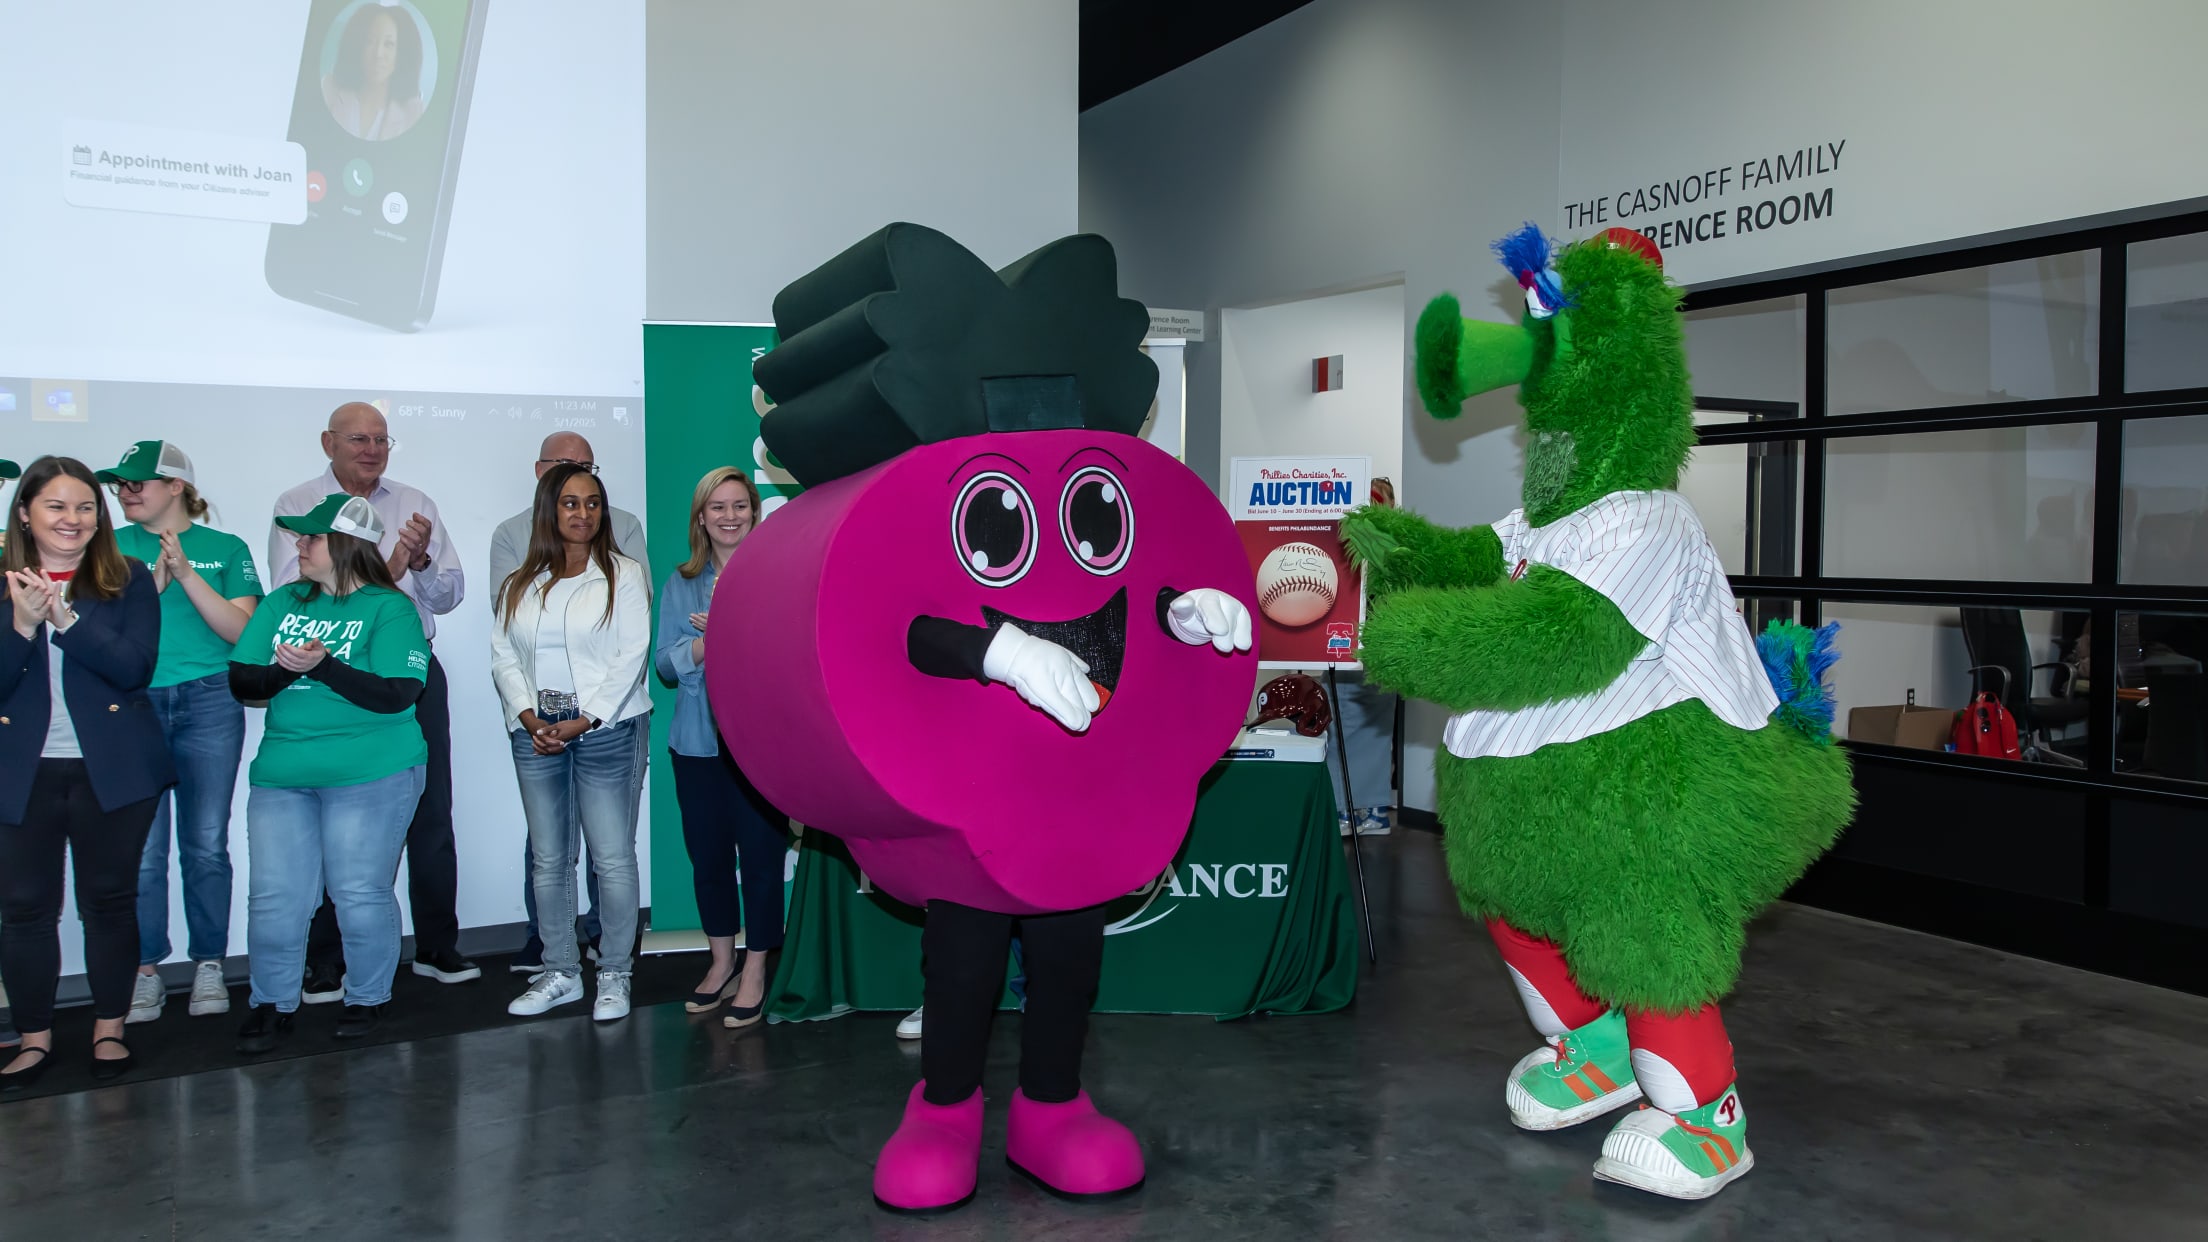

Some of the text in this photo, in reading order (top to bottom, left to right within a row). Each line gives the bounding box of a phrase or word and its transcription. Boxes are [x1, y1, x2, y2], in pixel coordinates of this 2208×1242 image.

[98, 150, 293, 183] Appointment with Joan
[1564, 138, 1847, 230] THE CASNOFF FAMILY
[1736, 188, 1834, 234] ROOM
[1157, 326, 1182, 335] Learning
[1182, 326, 1202, 335] Center
[398, 405, 467, 421] 68°F Sunny
[580, 401, 597, 411] AM
[1261, 467, 1348, 479] Phillies Charities, Inc.
[1249, 481, 1353, 506] AUCTION
[188, 559, 223, 570] Bank
[278, 612, 364, 641] READY TO
[1719, 1094, 1736, 1126] P
